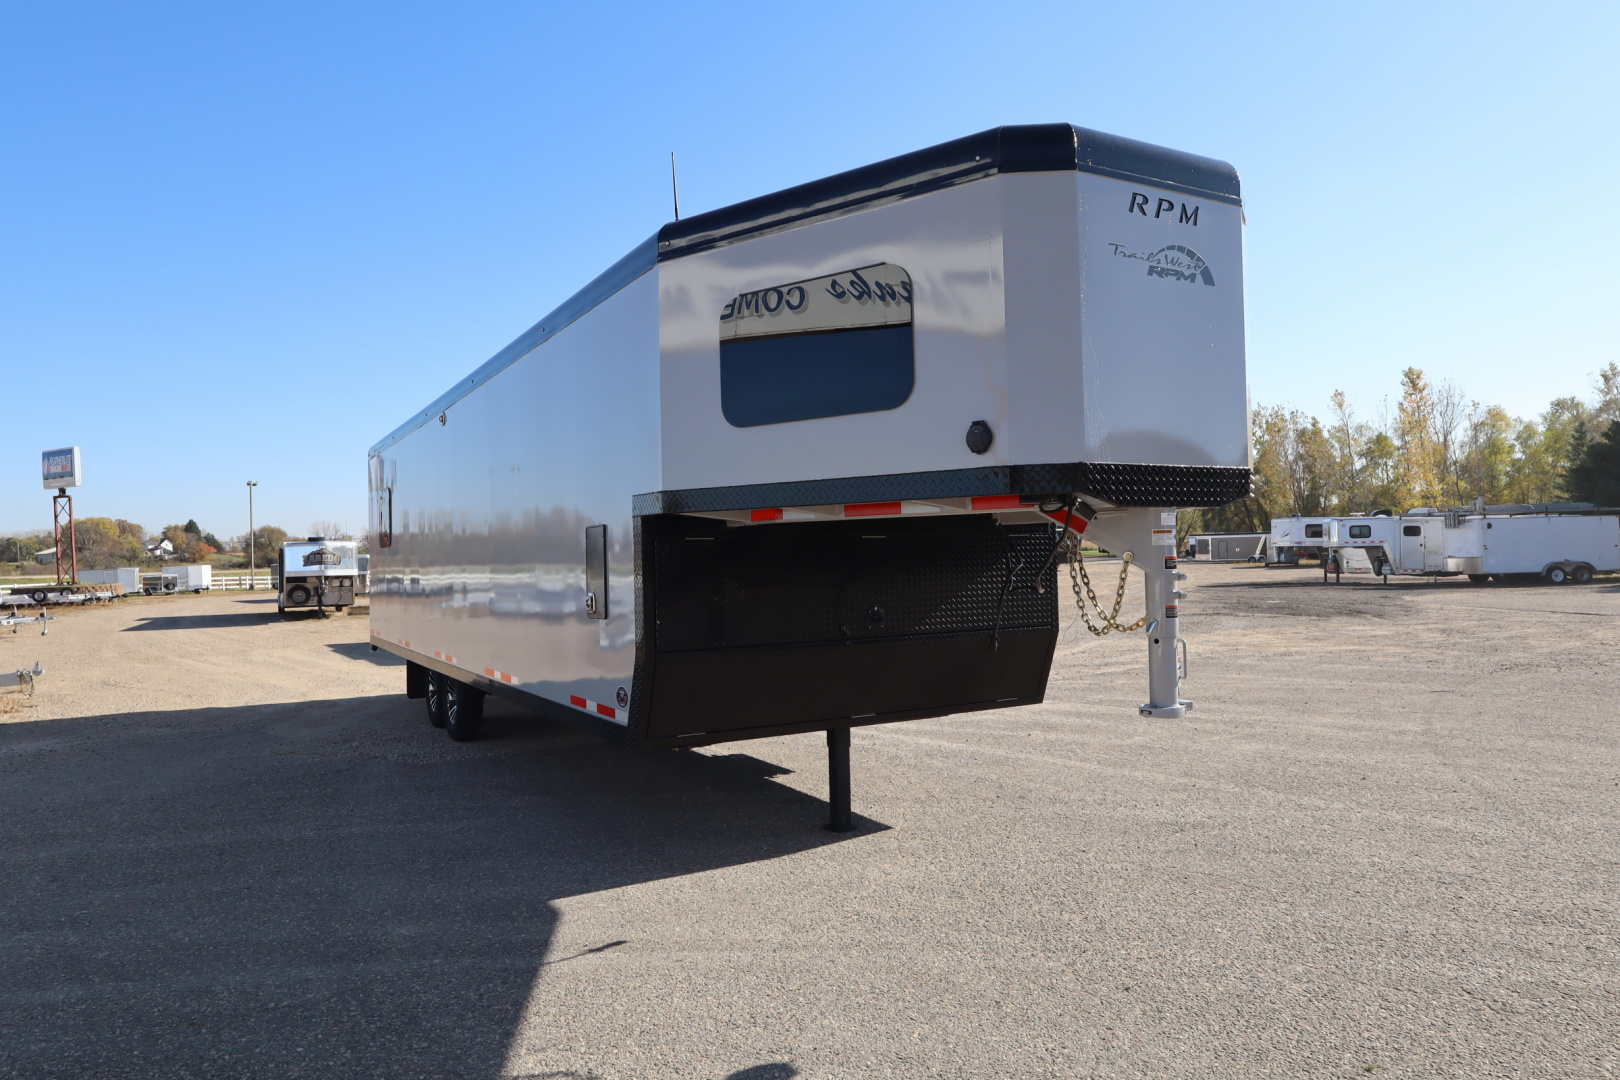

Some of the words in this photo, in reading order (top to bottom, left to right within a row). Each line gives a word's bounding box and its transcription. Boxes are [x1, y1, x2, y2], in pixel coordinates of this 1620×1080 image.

[1128, 191, 1200, 227] RPM
[1108, 242, 1162, 265] Trails
[1164, 253, 1203, 271] West
[1147, 264, 1197, 283] RPM
